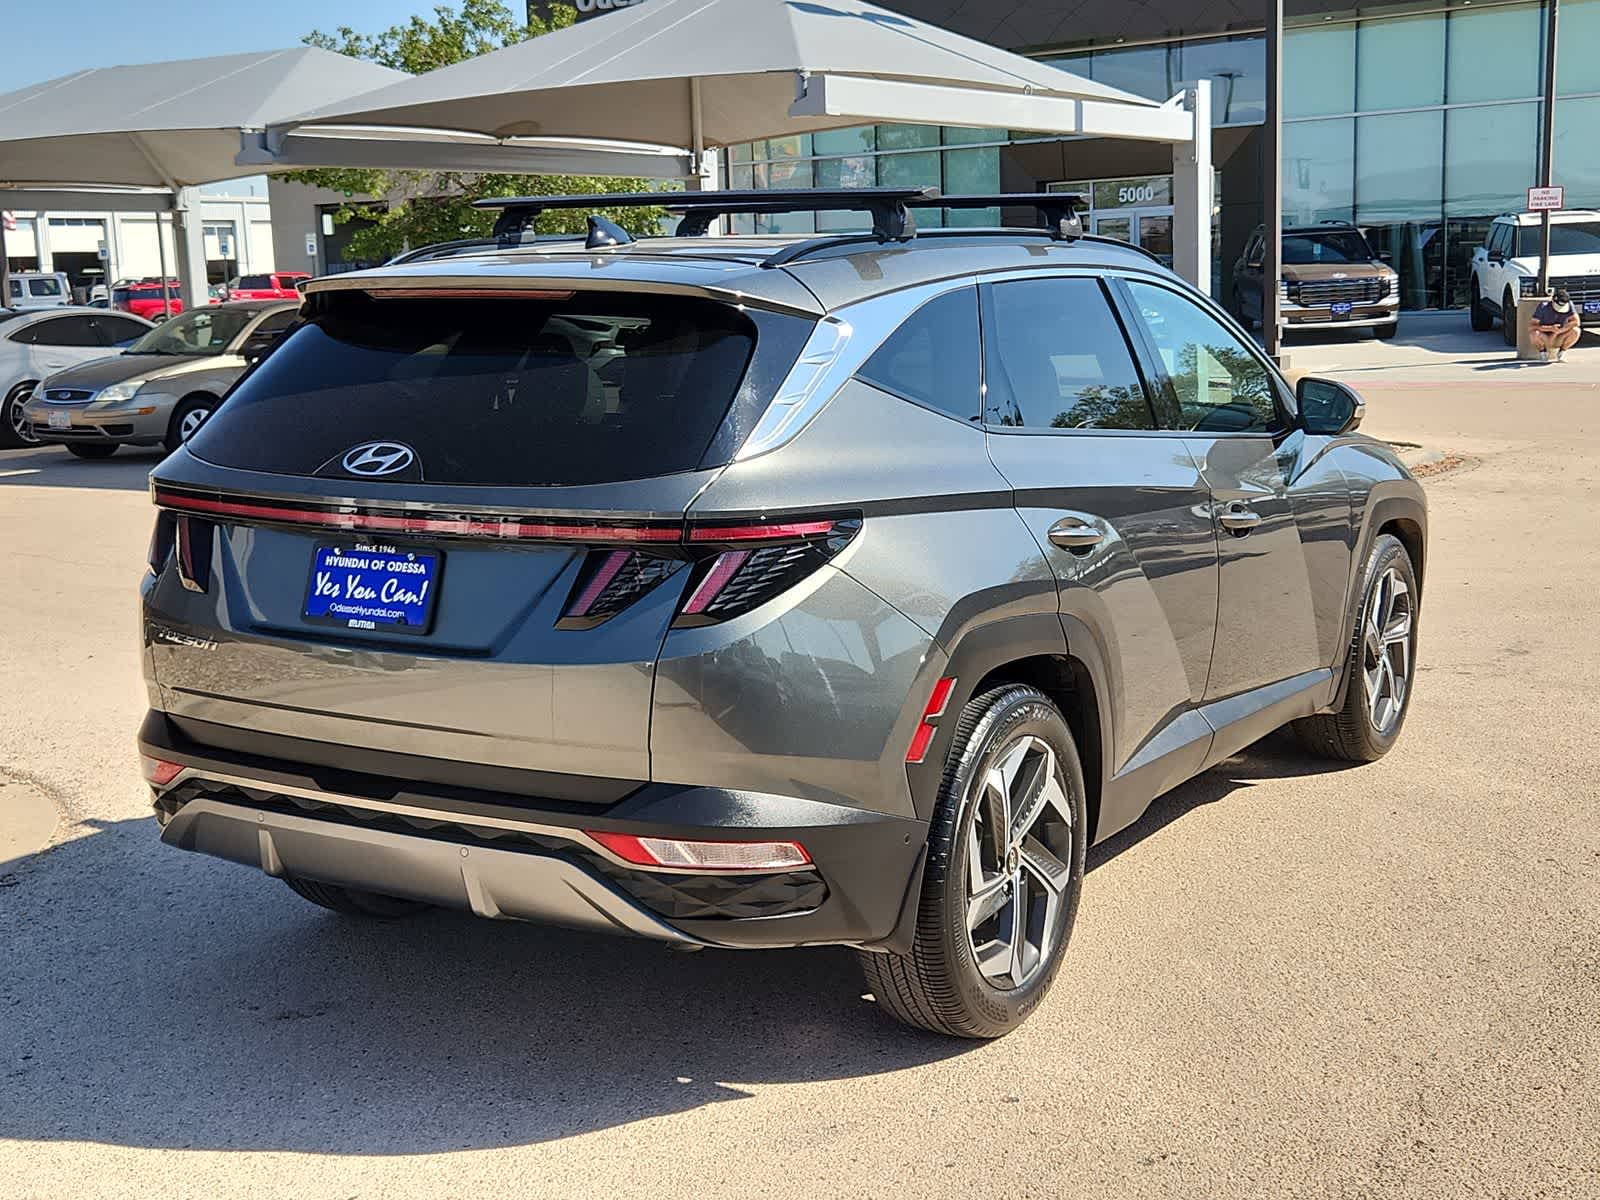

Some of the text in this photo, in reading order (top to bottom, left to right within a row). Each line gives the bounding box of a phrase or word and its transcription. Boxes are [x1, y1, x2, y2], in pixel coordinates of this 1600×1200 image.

[1118, 186, 1154, 203] 5000
[325, 555, 426, 575] HYUNDAI OF ODESSA
[314, 571, 429, 606] Yes You Can!
